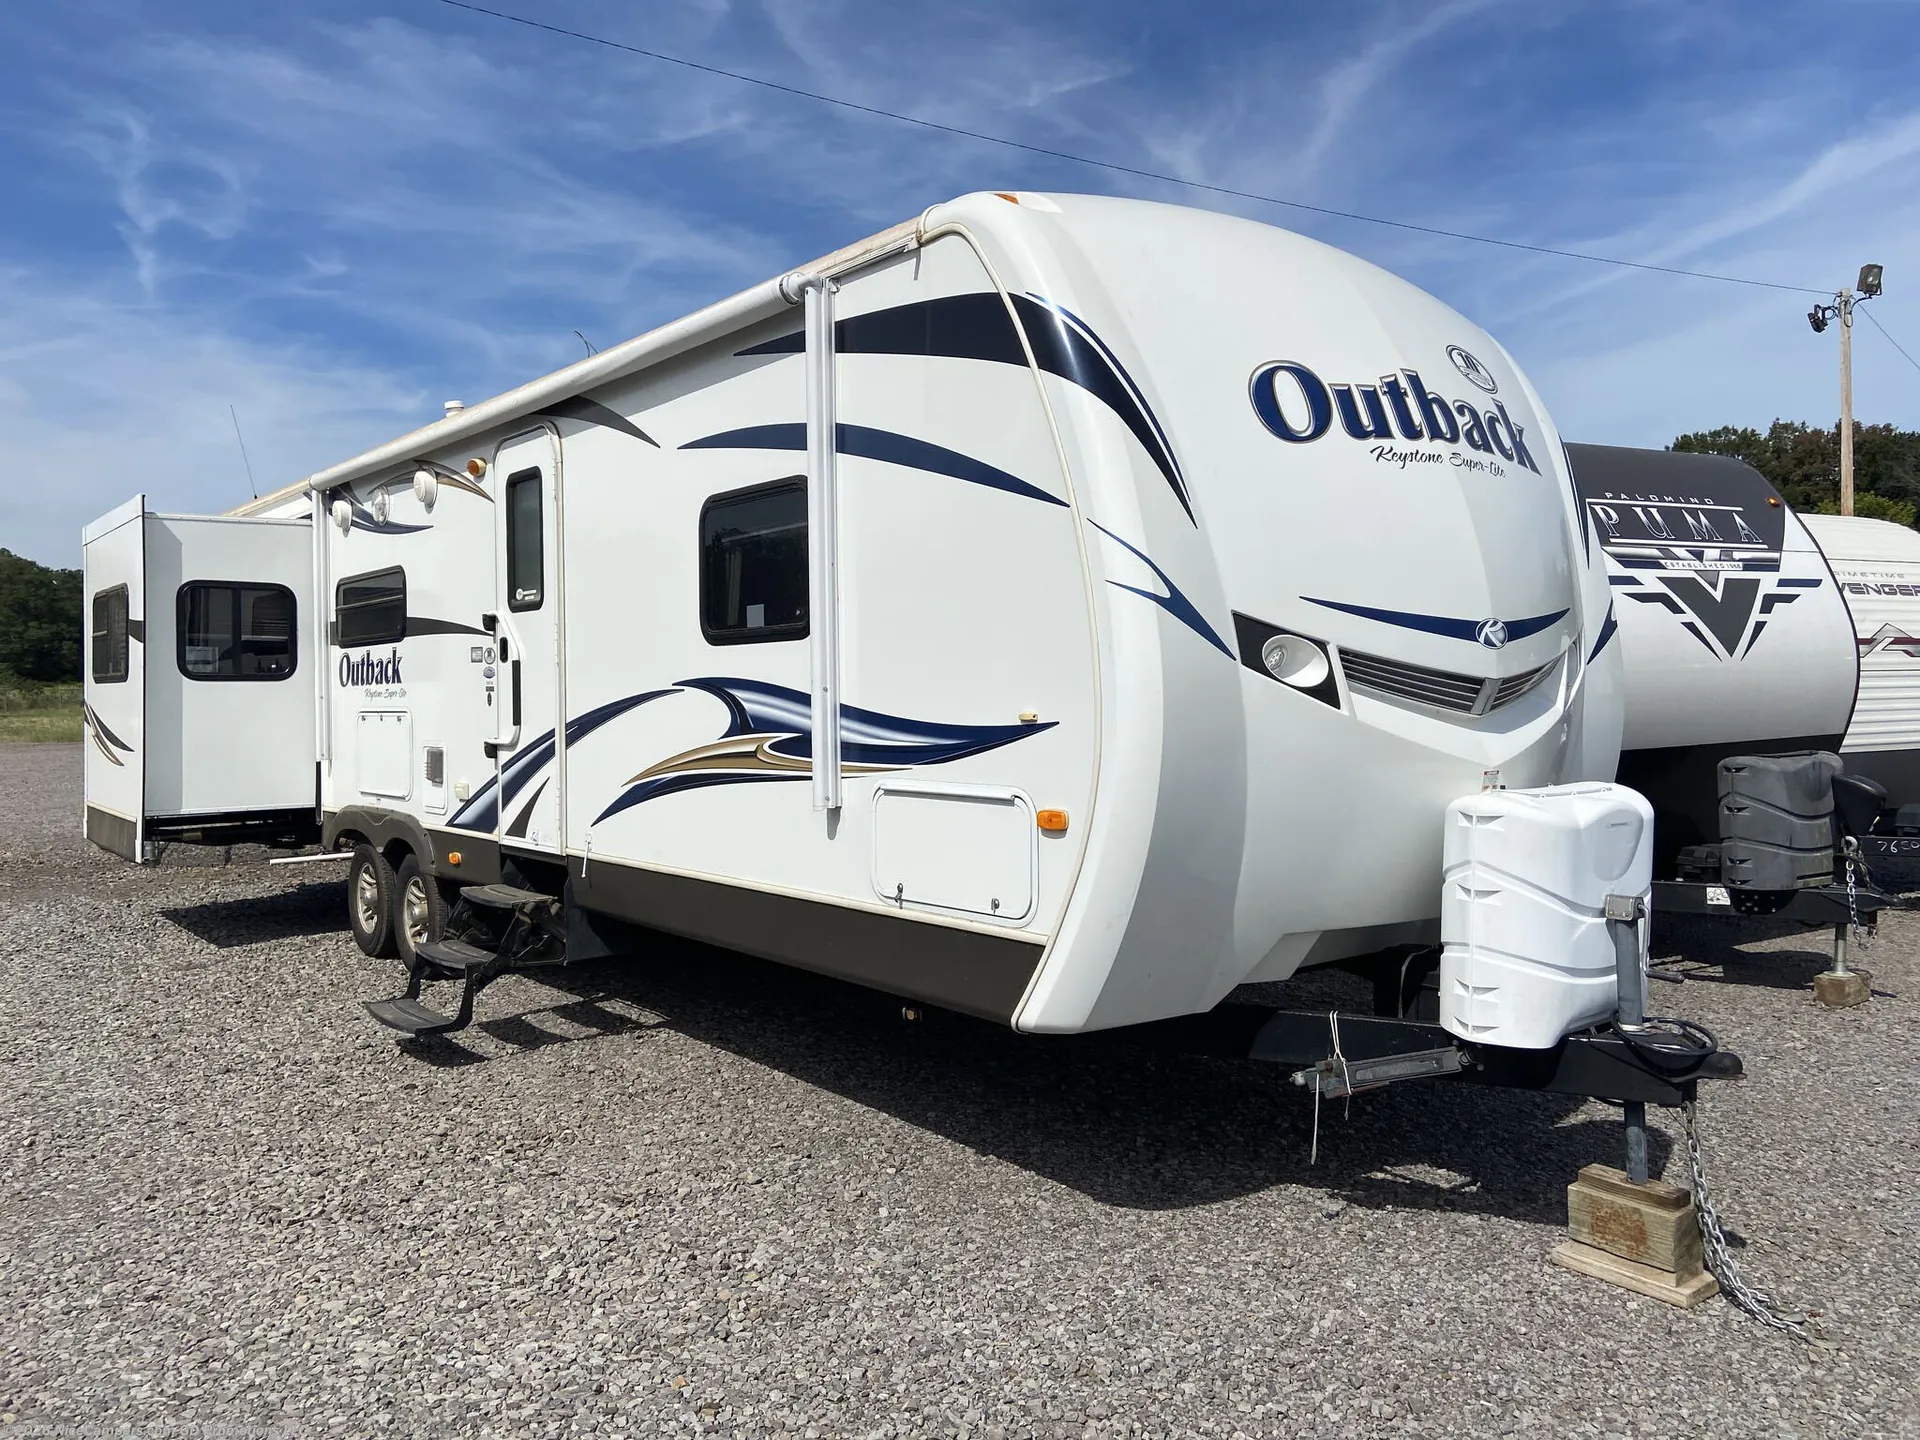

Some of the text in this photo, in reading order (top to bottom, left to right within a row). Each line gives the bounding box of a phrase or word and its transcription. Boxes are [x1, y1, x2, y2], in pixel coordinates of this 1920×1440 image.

[1248, 360, 1543, 477] Outback
[1369, 445, 1506, 478] Keystone Super-Lite
[1604, 492, 1714, 505] PALOMINO
[1591, 505, 1763, 543] PUMA
[339, 647, 402, 687] Outback
